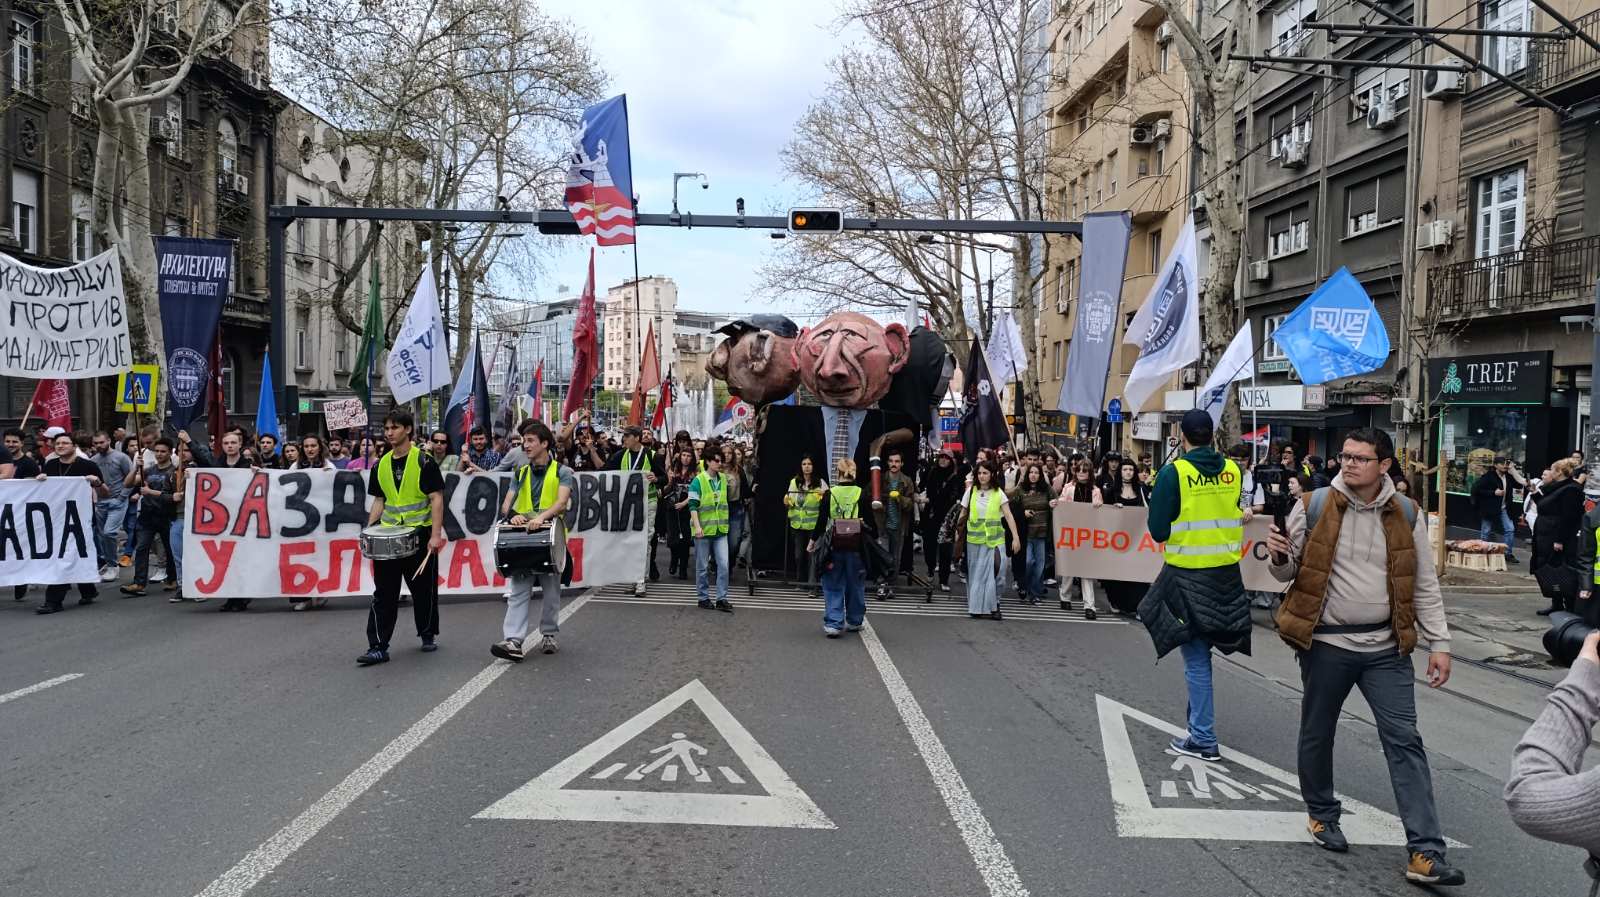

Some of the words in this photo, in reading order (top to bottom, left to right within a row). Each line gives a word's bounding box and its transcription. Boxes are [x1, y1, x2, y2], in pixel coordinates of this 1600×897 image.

[160, 253, 226, 280] АРХИТЕКТУРА
[10, 296, 122, 332] ПРОТИВ
[1466, 362, 1518, 384] TREF
[0, 500, 88, 561] ADA
[1056, 527, 1131, 553] ДРВО
[195, 539, 237, 594] У
